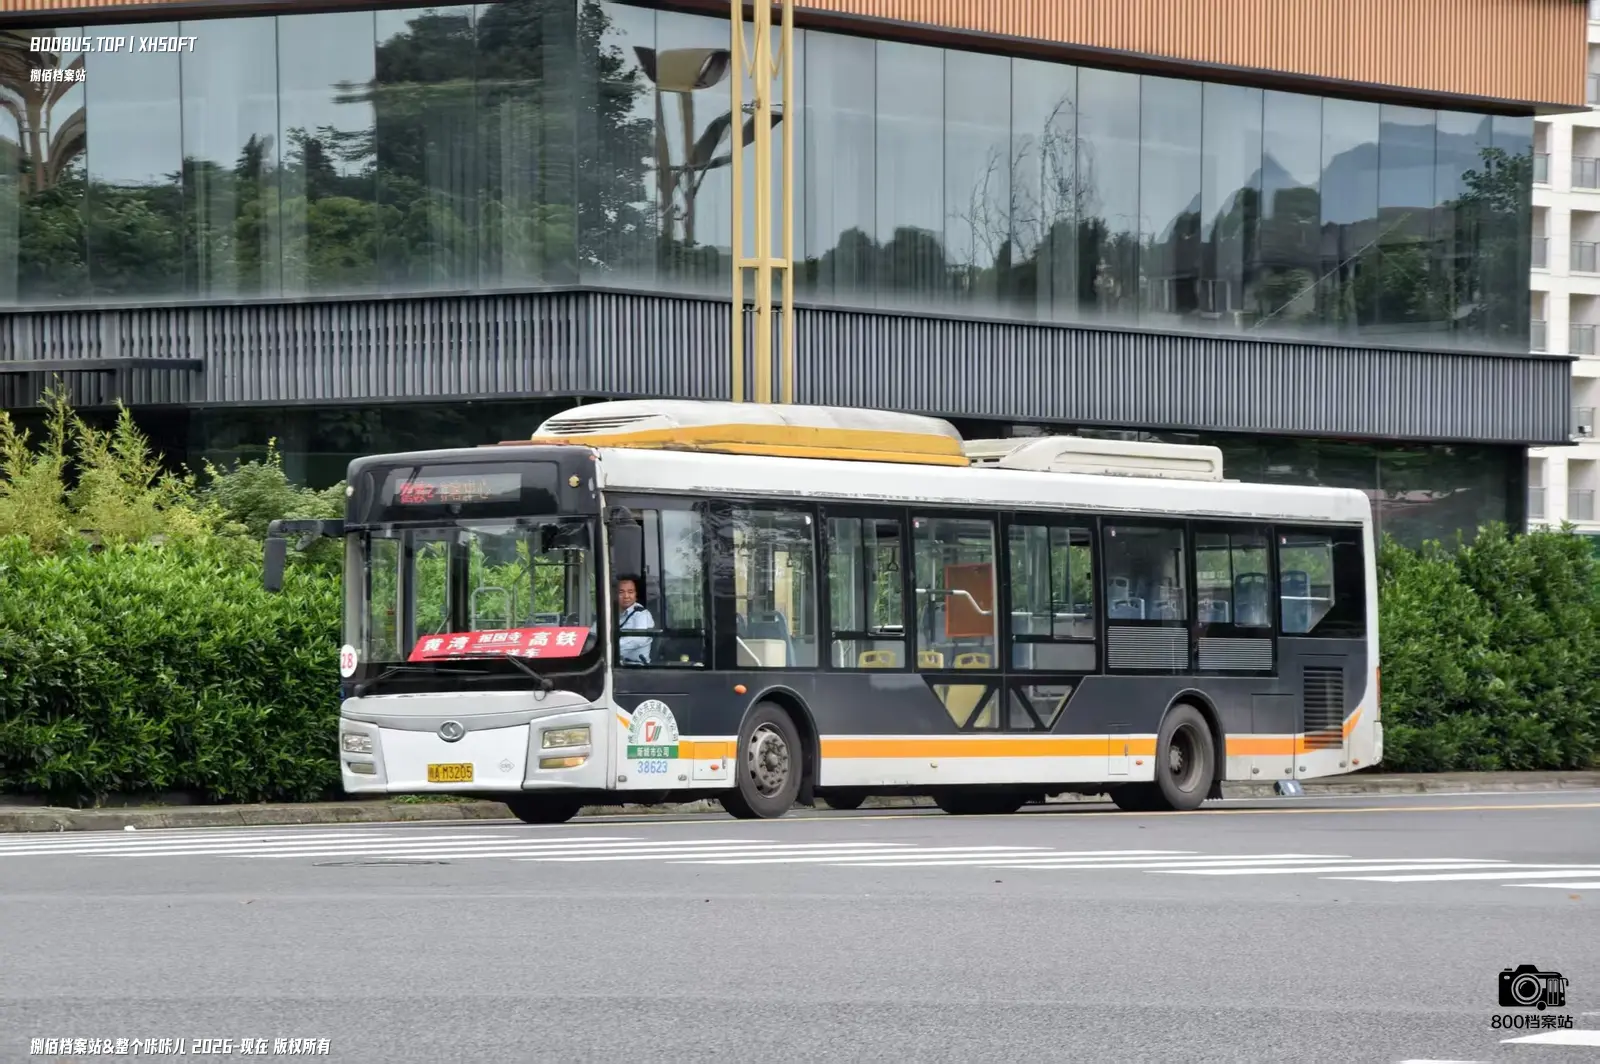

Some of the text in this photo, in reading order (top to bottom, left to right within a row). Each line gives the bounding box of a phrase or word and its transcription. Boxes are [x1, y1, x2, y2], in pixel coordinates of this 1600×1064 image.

[478, 631, 523, 643] 报国寺
[528, 631, 579, 647] 高铁
[341, 653, 354, 669] 28
[637, 761, 668, 774] 38623
